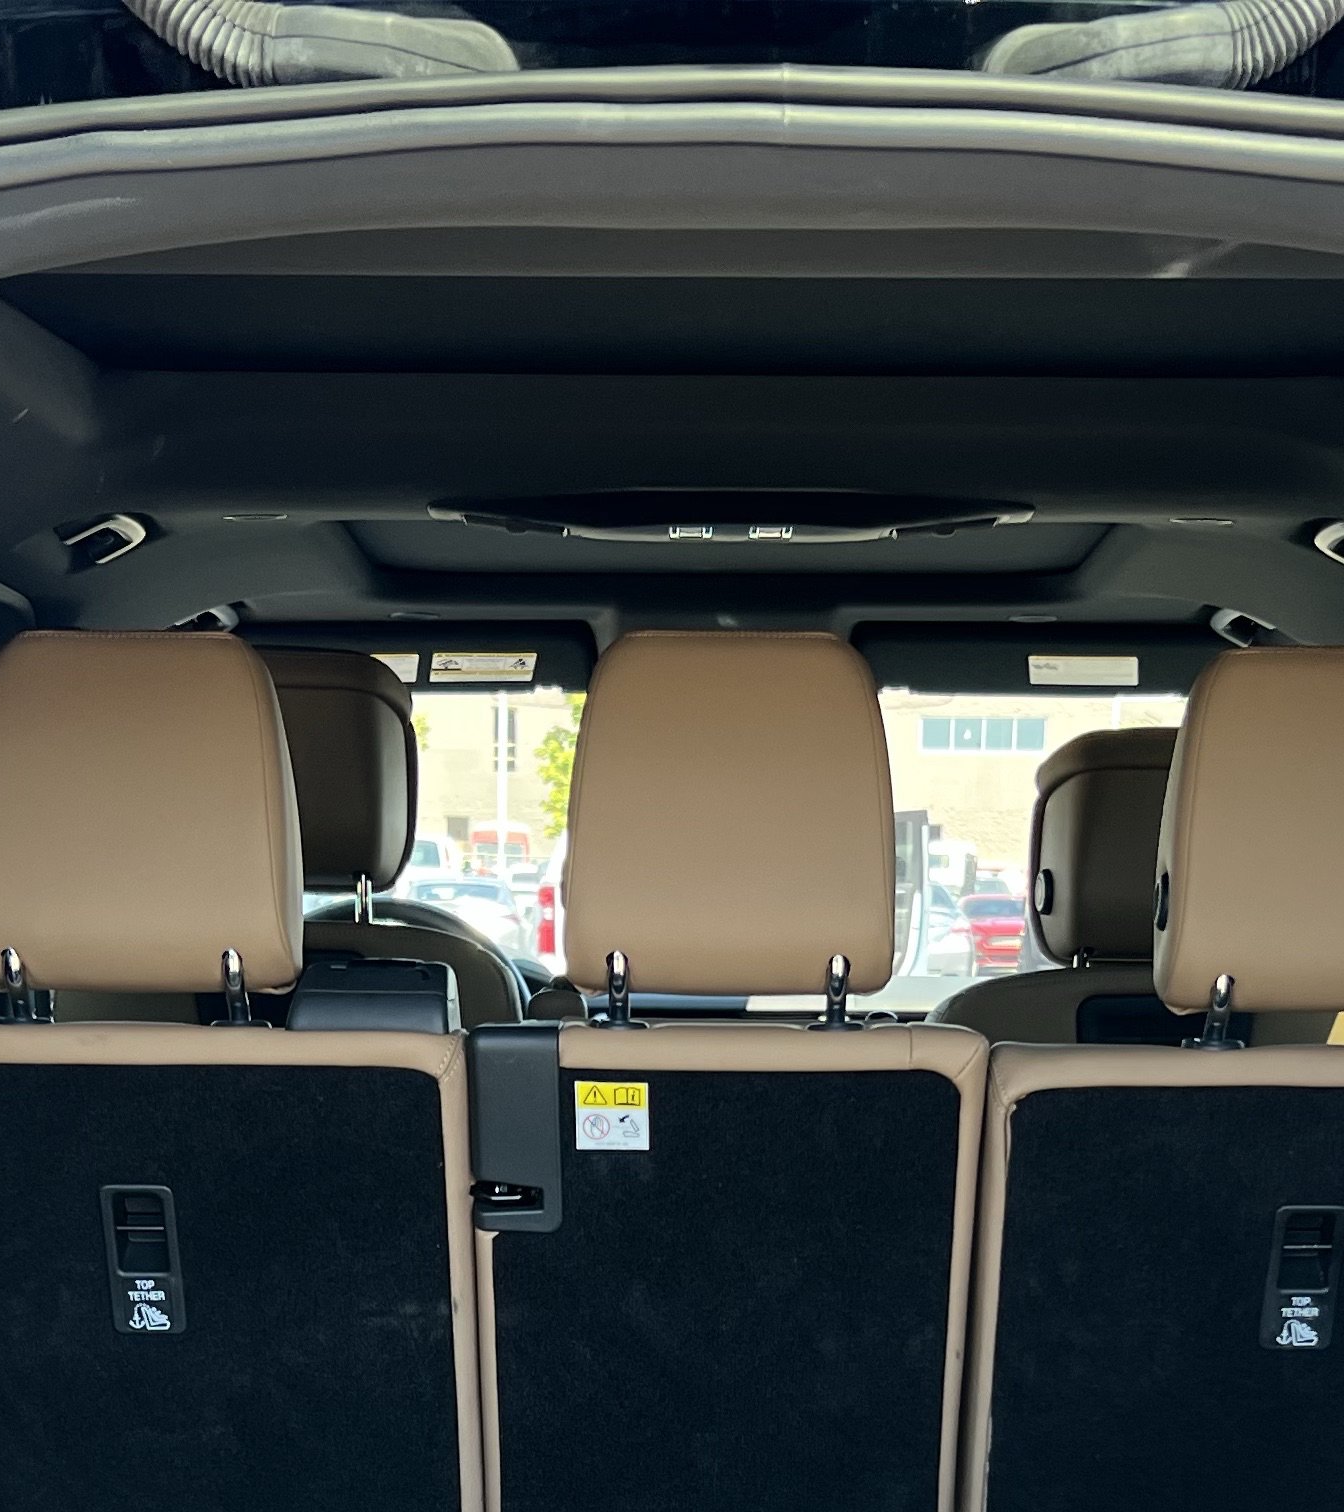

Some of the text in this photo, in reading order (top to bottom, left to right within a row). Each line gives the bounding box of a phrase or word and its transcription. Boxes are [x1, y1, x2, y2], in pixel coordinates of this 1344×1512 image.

[135, 1279, 155, 1290] TOP
[128, 1290, 165, 1301] TETHER
[1291, 1296, 1311, 1306] TOP
